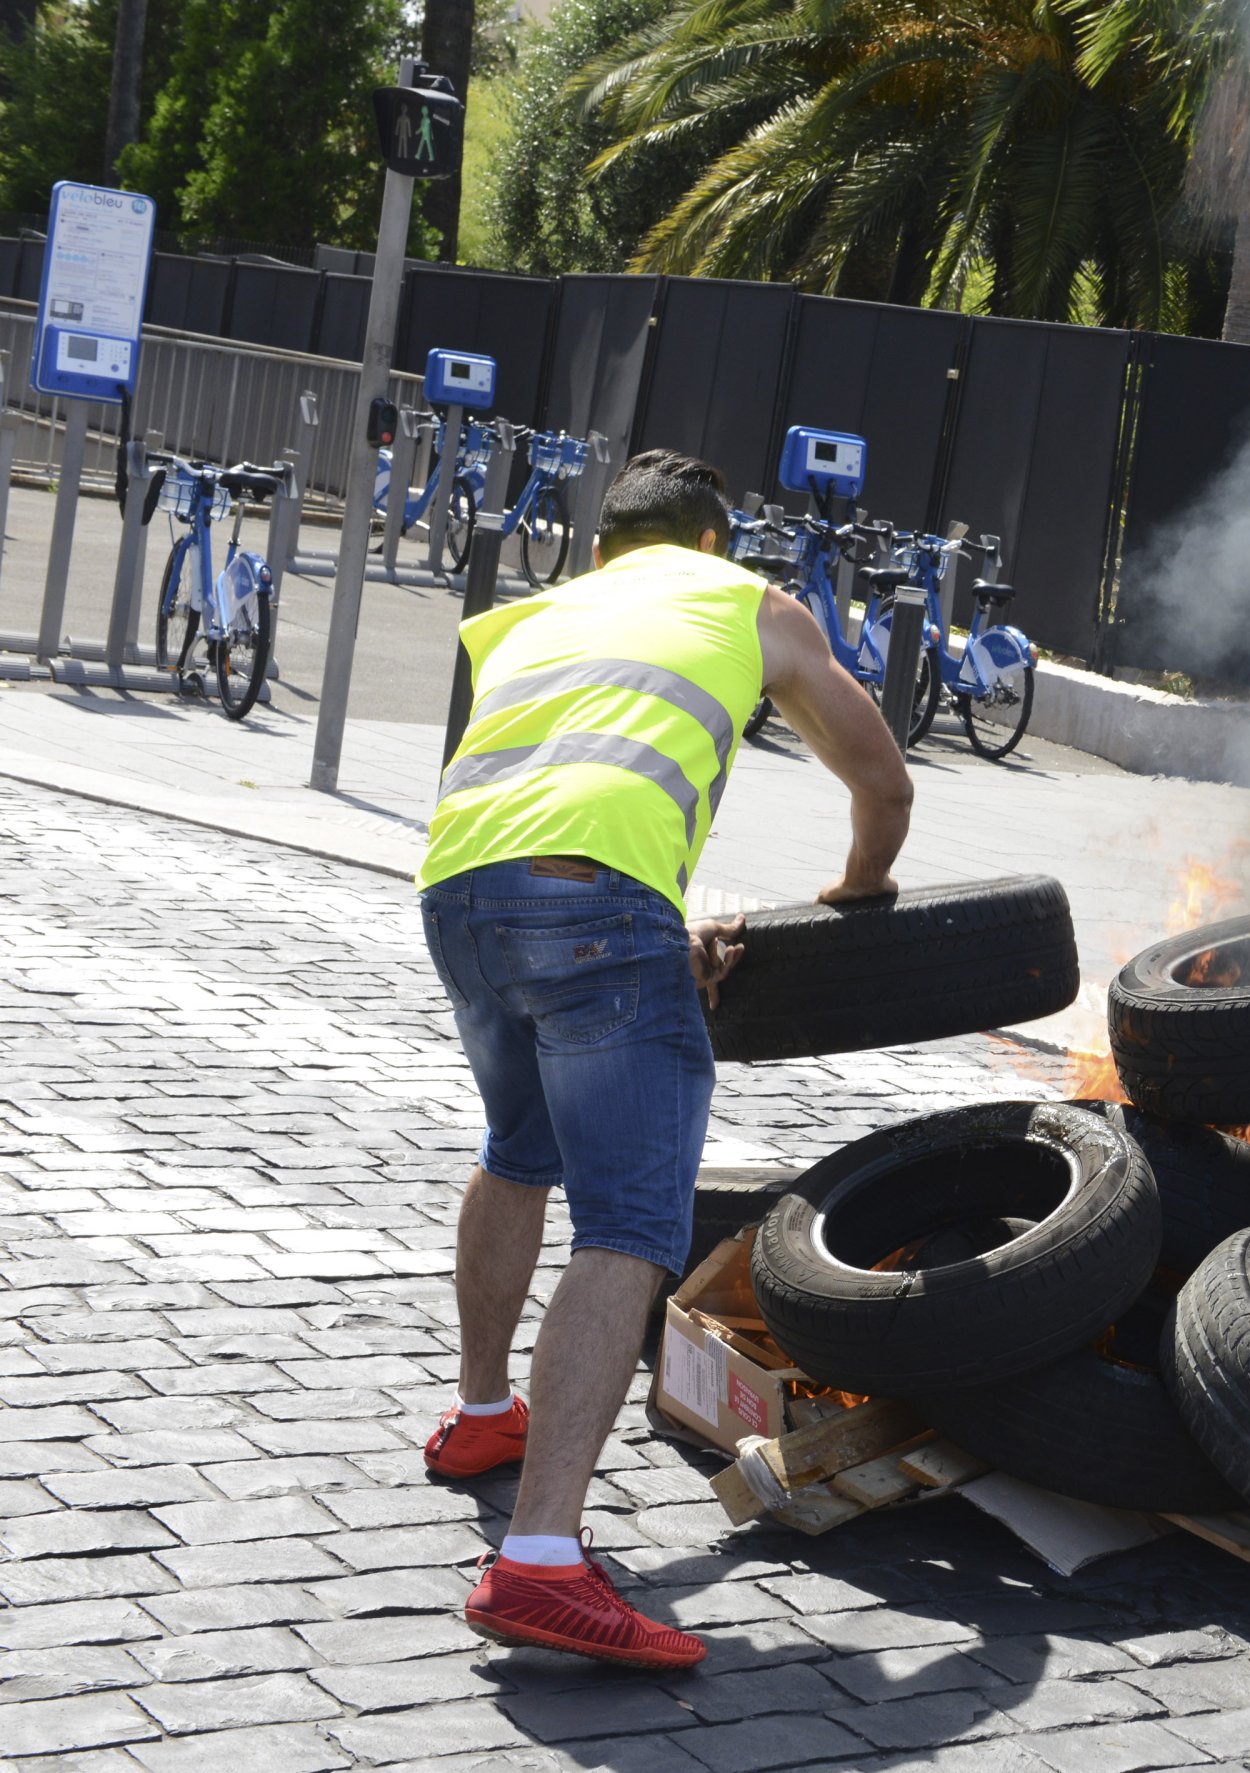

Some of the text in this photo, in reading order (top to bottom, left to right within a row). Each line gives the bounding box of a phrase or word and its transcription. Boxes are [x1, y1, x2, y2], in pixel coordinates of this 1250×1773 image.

[765, 1211, 797, 1275] Matador
[736, 1378, 760, 1402] LIVRAISON
[739, 1390, 757, 1410] BON DE
